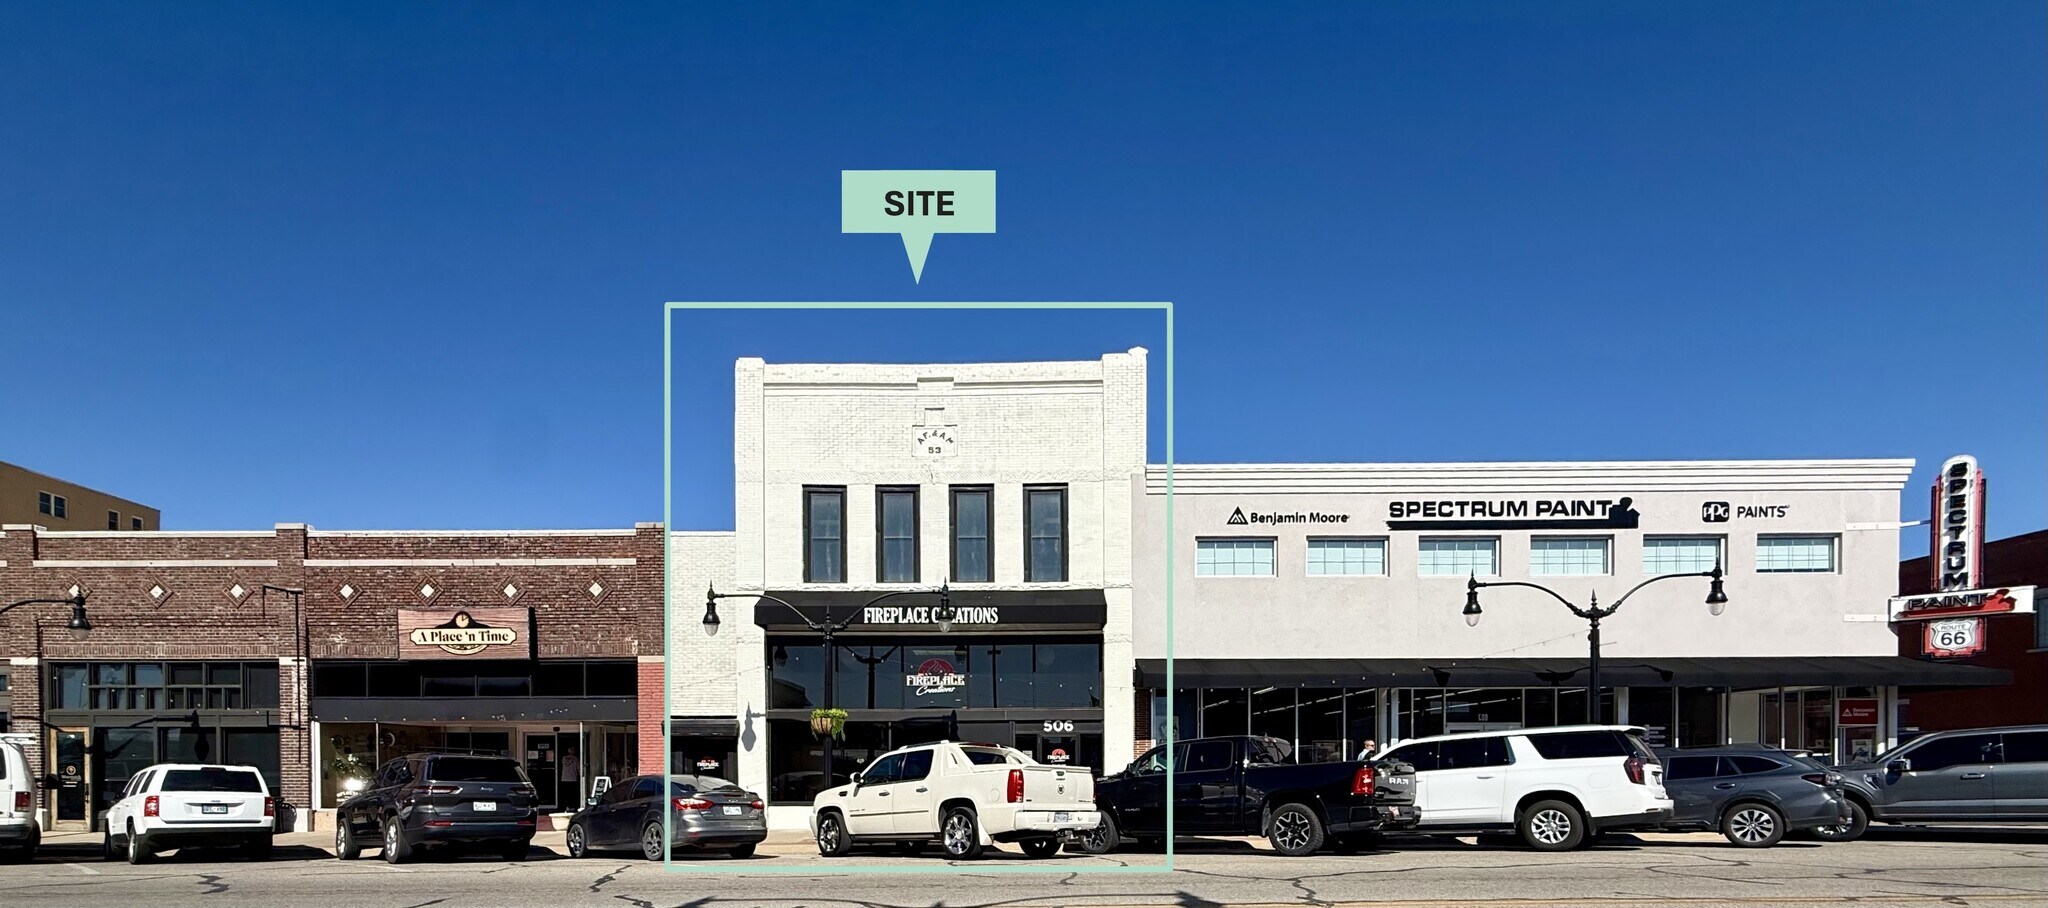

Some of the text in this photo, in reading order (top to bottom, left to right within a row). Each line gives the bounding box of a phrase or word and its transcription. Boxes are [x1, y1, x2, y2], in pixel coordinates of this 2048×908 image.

[928, 446, 942, 454] 53
[1388, 500, 1613, 518] SPECTRUM PAINT
[1703, 503, 1786, 521] PPG PAINTS
[1250, 511, 1349, 526] Benjamin Moore
[1943, 461, 1969, 588] SPECTRUM
[1907, 592, 1989, 611] PAINT
[863, 606, 999, 624] FIREPLACE CEATIONS
[1940, 623, 1966, 631] ROUTE
[418, 631, 428, 642] A
[430, 630, 463, 642] Place
[478, 630, 509, 642] Time
[1940, 631, 1966, 646] 66
[906, 673, 966, 686] FIREPLACE
[916, 685, 956, 696] Creations
[1043, 720, 1074, 732] 506
